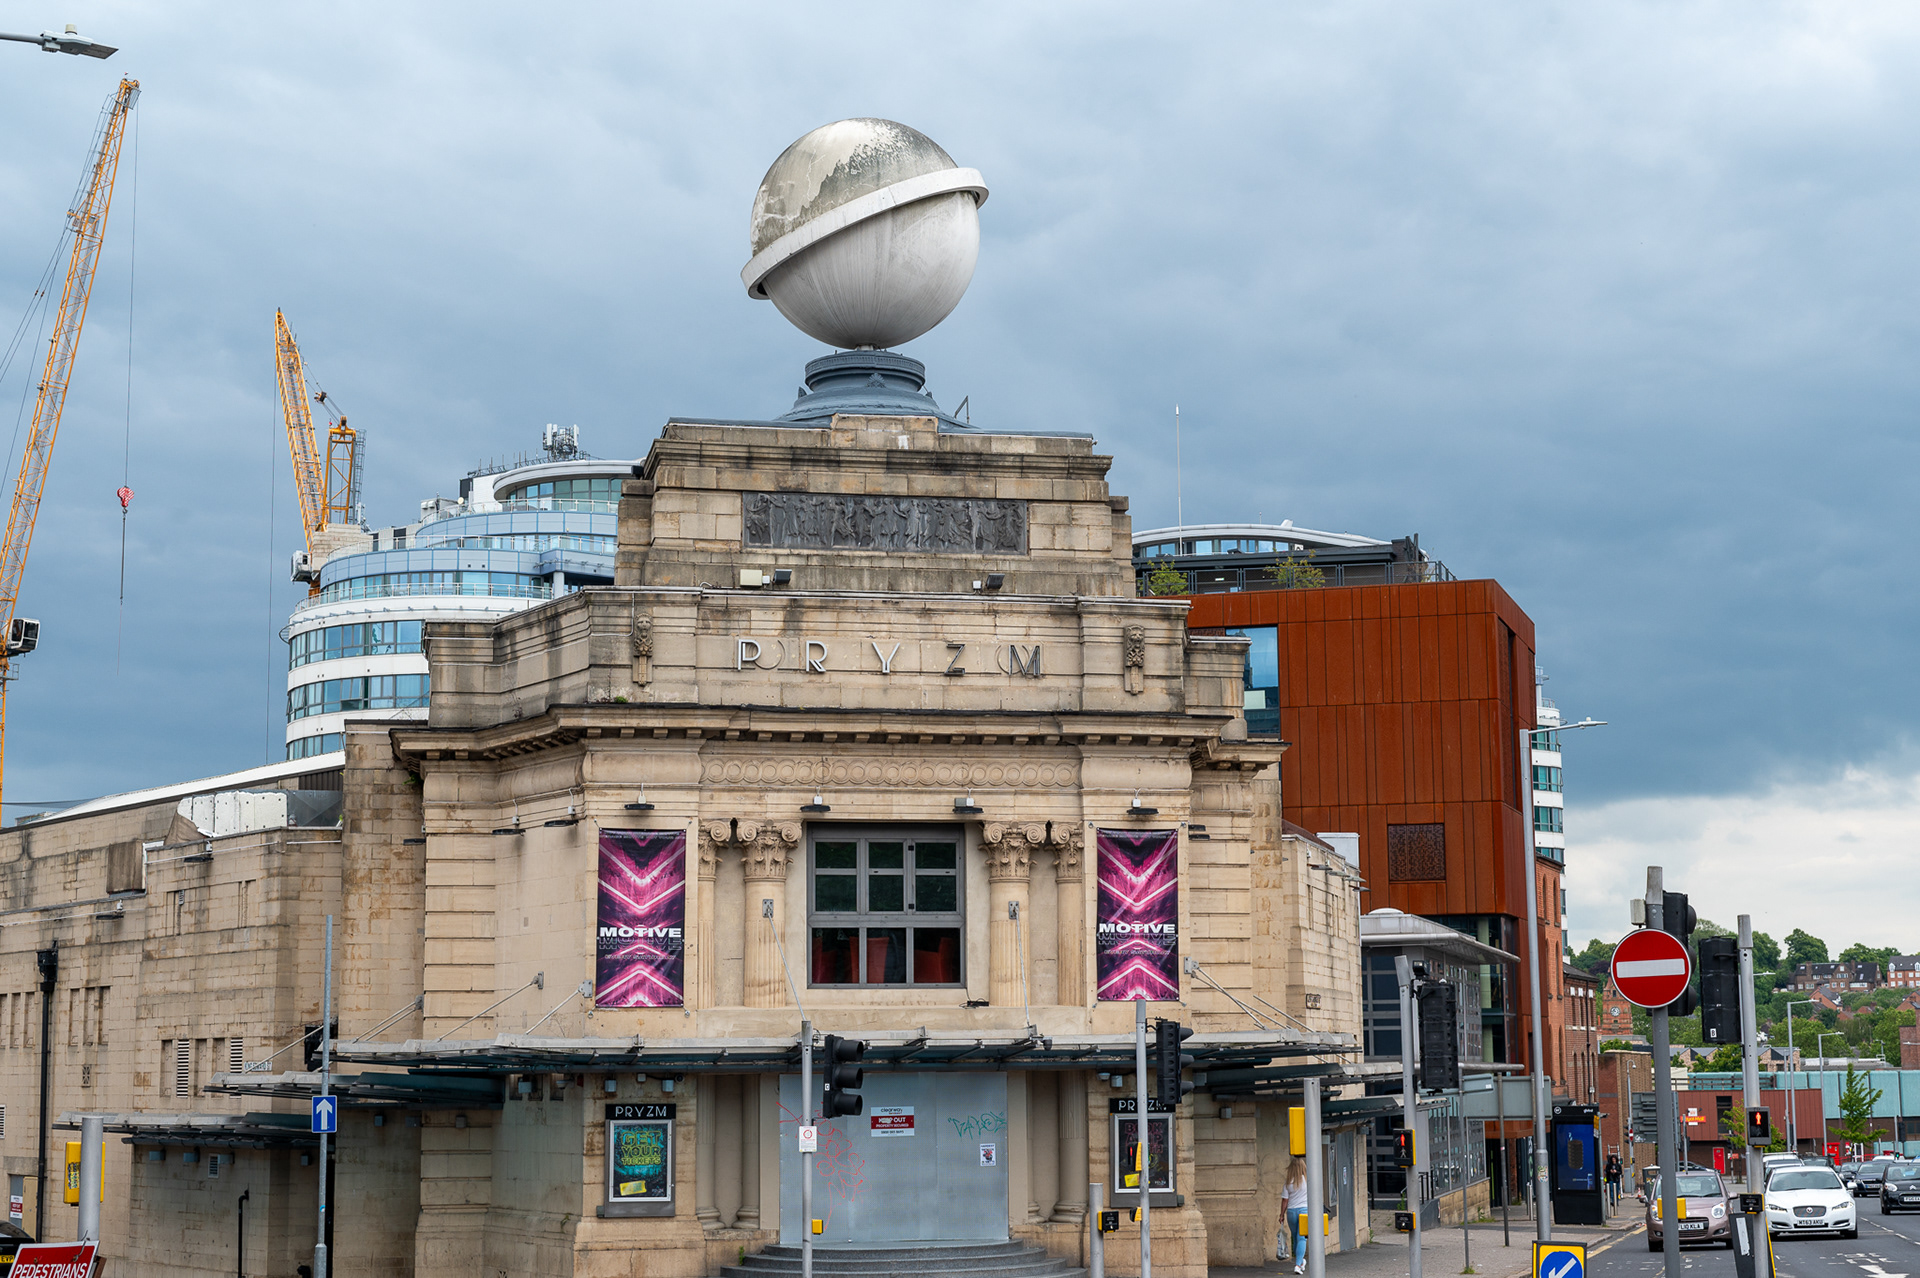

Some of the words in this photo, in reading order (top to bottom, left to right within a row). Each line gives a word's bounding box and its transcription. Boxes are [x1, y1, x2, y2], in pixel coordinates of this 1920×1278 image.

[737, 639, 1041, 677] PRYZM
[599, 927, 682, 938] MOTIVE
[1099, 923, 1176, 934] MOTIVE
[615, 1106, 667, 1117] PRYZM
[621, 1130, 662, 1146] GET
[621, 1145, 661, 1158] YOUR
[621, 1156, 661, 1166] TICKETS
[13, 1263, 88, 1278] PEDESTRIANS
